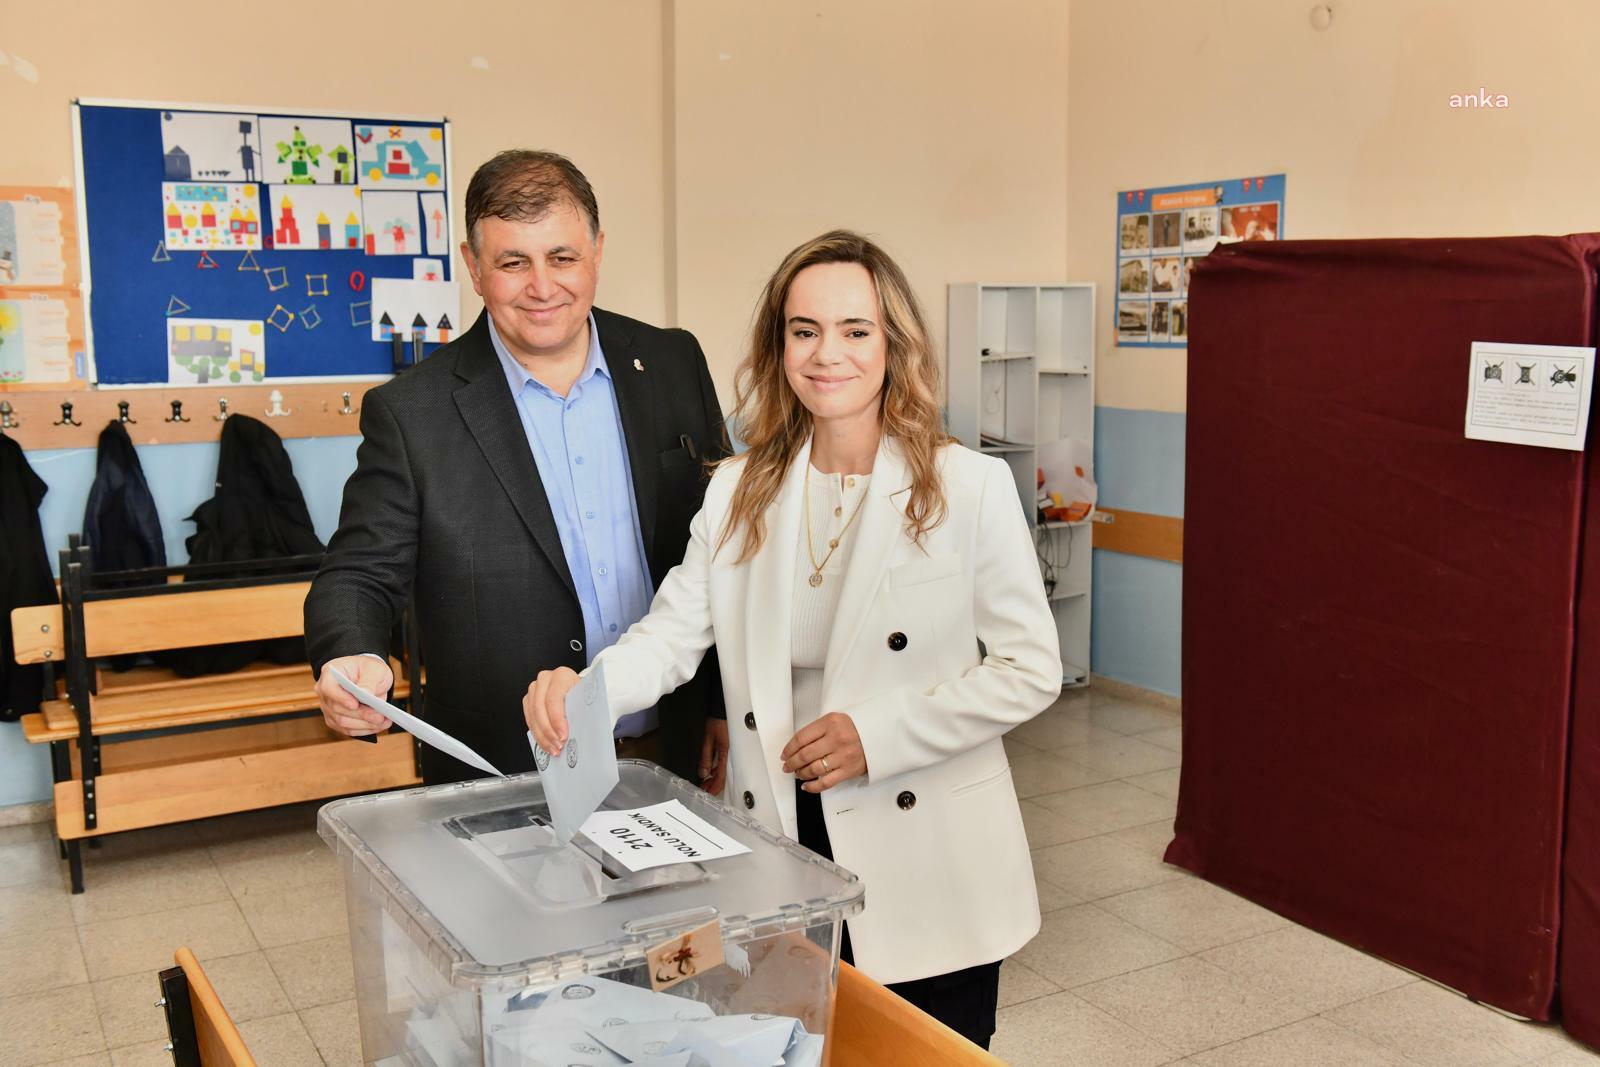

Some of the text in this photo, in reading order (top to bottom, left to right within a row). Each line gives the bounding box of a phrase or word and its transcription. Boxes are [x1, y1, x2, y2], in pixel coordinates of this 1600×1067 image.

[609, 827, 653, 850] 2110
[628, 812, 701, 858] NOLU SANDIK
